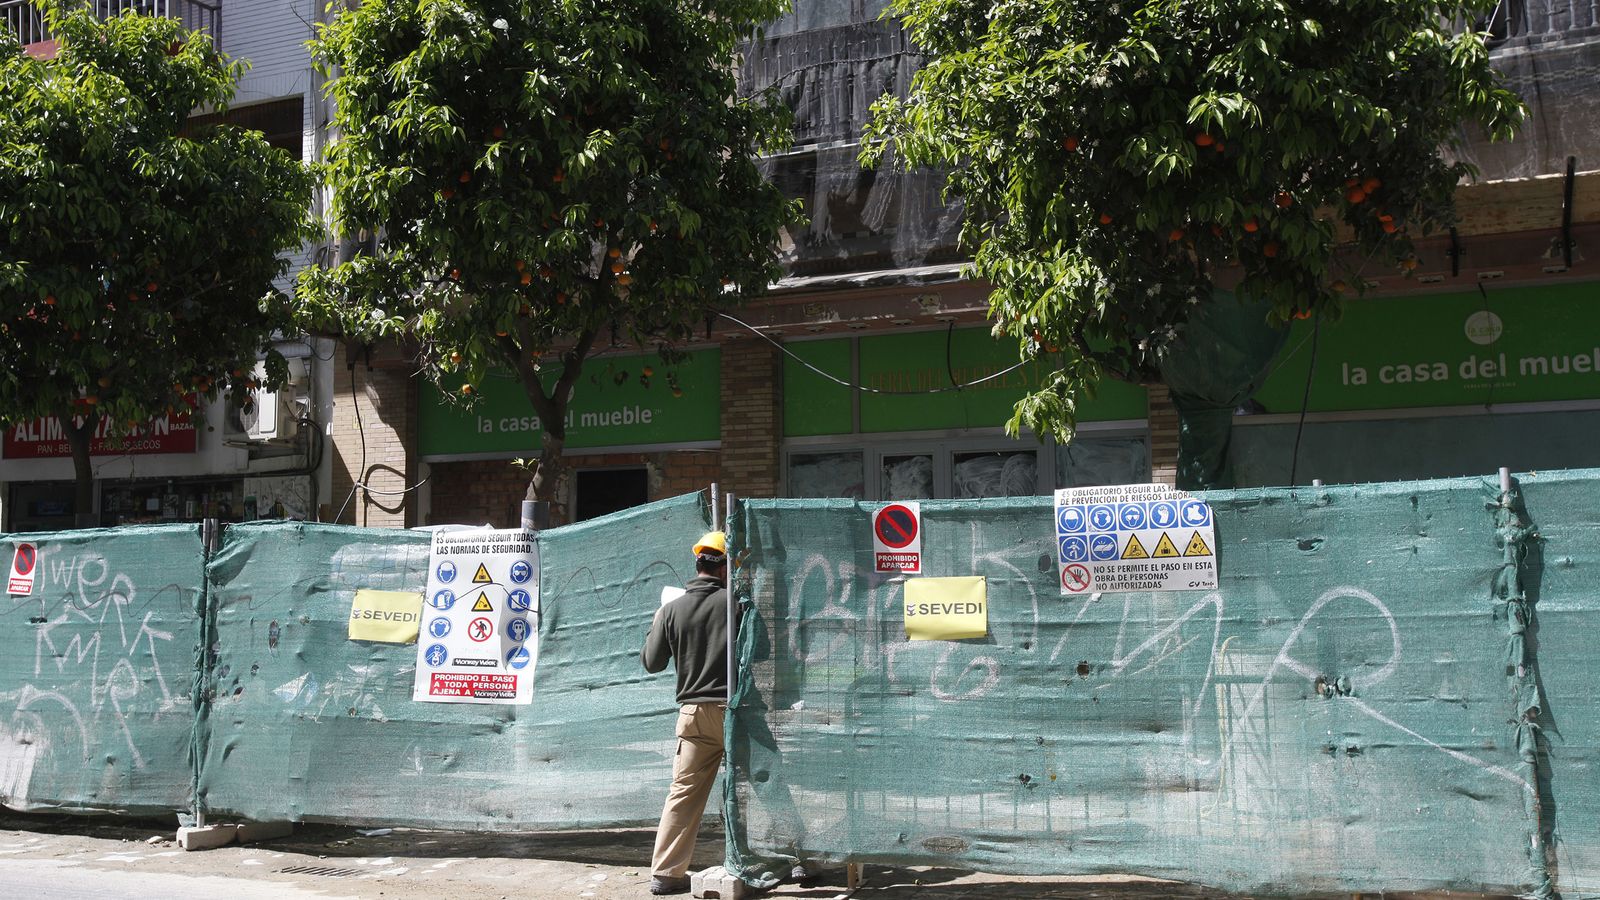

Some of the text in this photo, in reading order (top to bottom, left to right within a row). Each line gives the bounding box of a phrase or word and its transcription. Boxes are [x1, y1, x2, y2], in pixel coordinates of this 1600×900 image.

[1342, 362, 1368, 386] la
[1379, 361, 1449, 384] casa
[1459, 353, 1506, 380] del
[477, 415, 493, 433] la
[500, 415, 541, 432] casa
[581, 404, 652, 428] mueble
[37, 444, 53, 454] PAN
[1072, 486, 1123, 497] OBLIGATORIO
[1124, 485, 1151, 495] SEGUIR
[1153, 484, 1167, 493] LAS
[1060, 497, 1070, 506] DE
[1119, 494, 1129, 503] DE
[1131, 492, 1162, 502] RIESGOS
[488, 533, 512, 543] SEGUIR
[513, 532, 535, 543] TODAS
[436, 543, 534, 555] LAS NORMAS DE SEGURIDAD.
[1093, 560, 1213, 574] NO SE PERMITE EL PASO EN ESTA
[1095, 571, 1169, 582] OBRA DE PERSONAS
[1096, 582, 1108, 591] NO
[1109, 580, 1162, 590] AUTORIZADAS
[918, 602, 983, 615] SEVEDI
[362, 610, 417, 623] SEVEDI
[434, 674, 480, 682] PROHIBIDO
[492, 675, 515, 683] PASO
[472, 682, 514, 690] PERSONA
